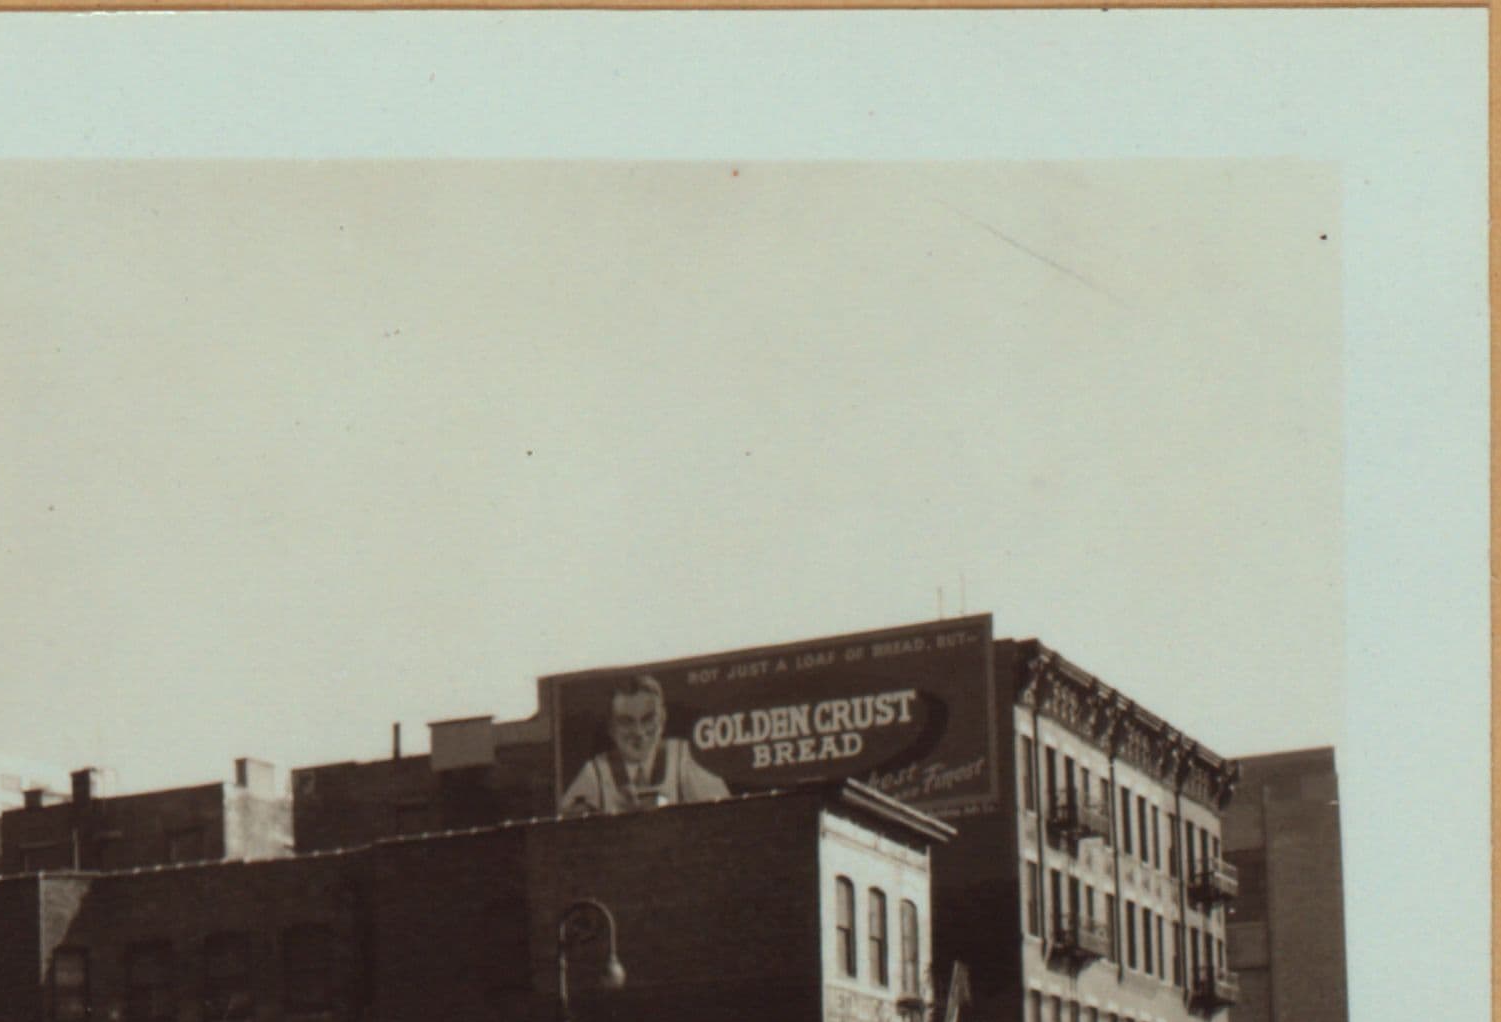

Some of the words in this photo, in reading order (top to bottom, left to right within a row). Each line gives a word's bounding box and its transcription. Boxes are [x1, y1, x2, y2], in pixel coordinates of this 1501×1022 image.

[687, 668, 719, 685] NOT
[726, 661, 768, 680] JUST
[775, 656, 788, 672] A
[795, 651, 835, 671] LOAF
[844, 646, 865, 662] OF
[693, 702, 810, 750] GOLDEN
[813, 689, 917, 734] CRUST
[752, 732, 863, 769] BREAD
